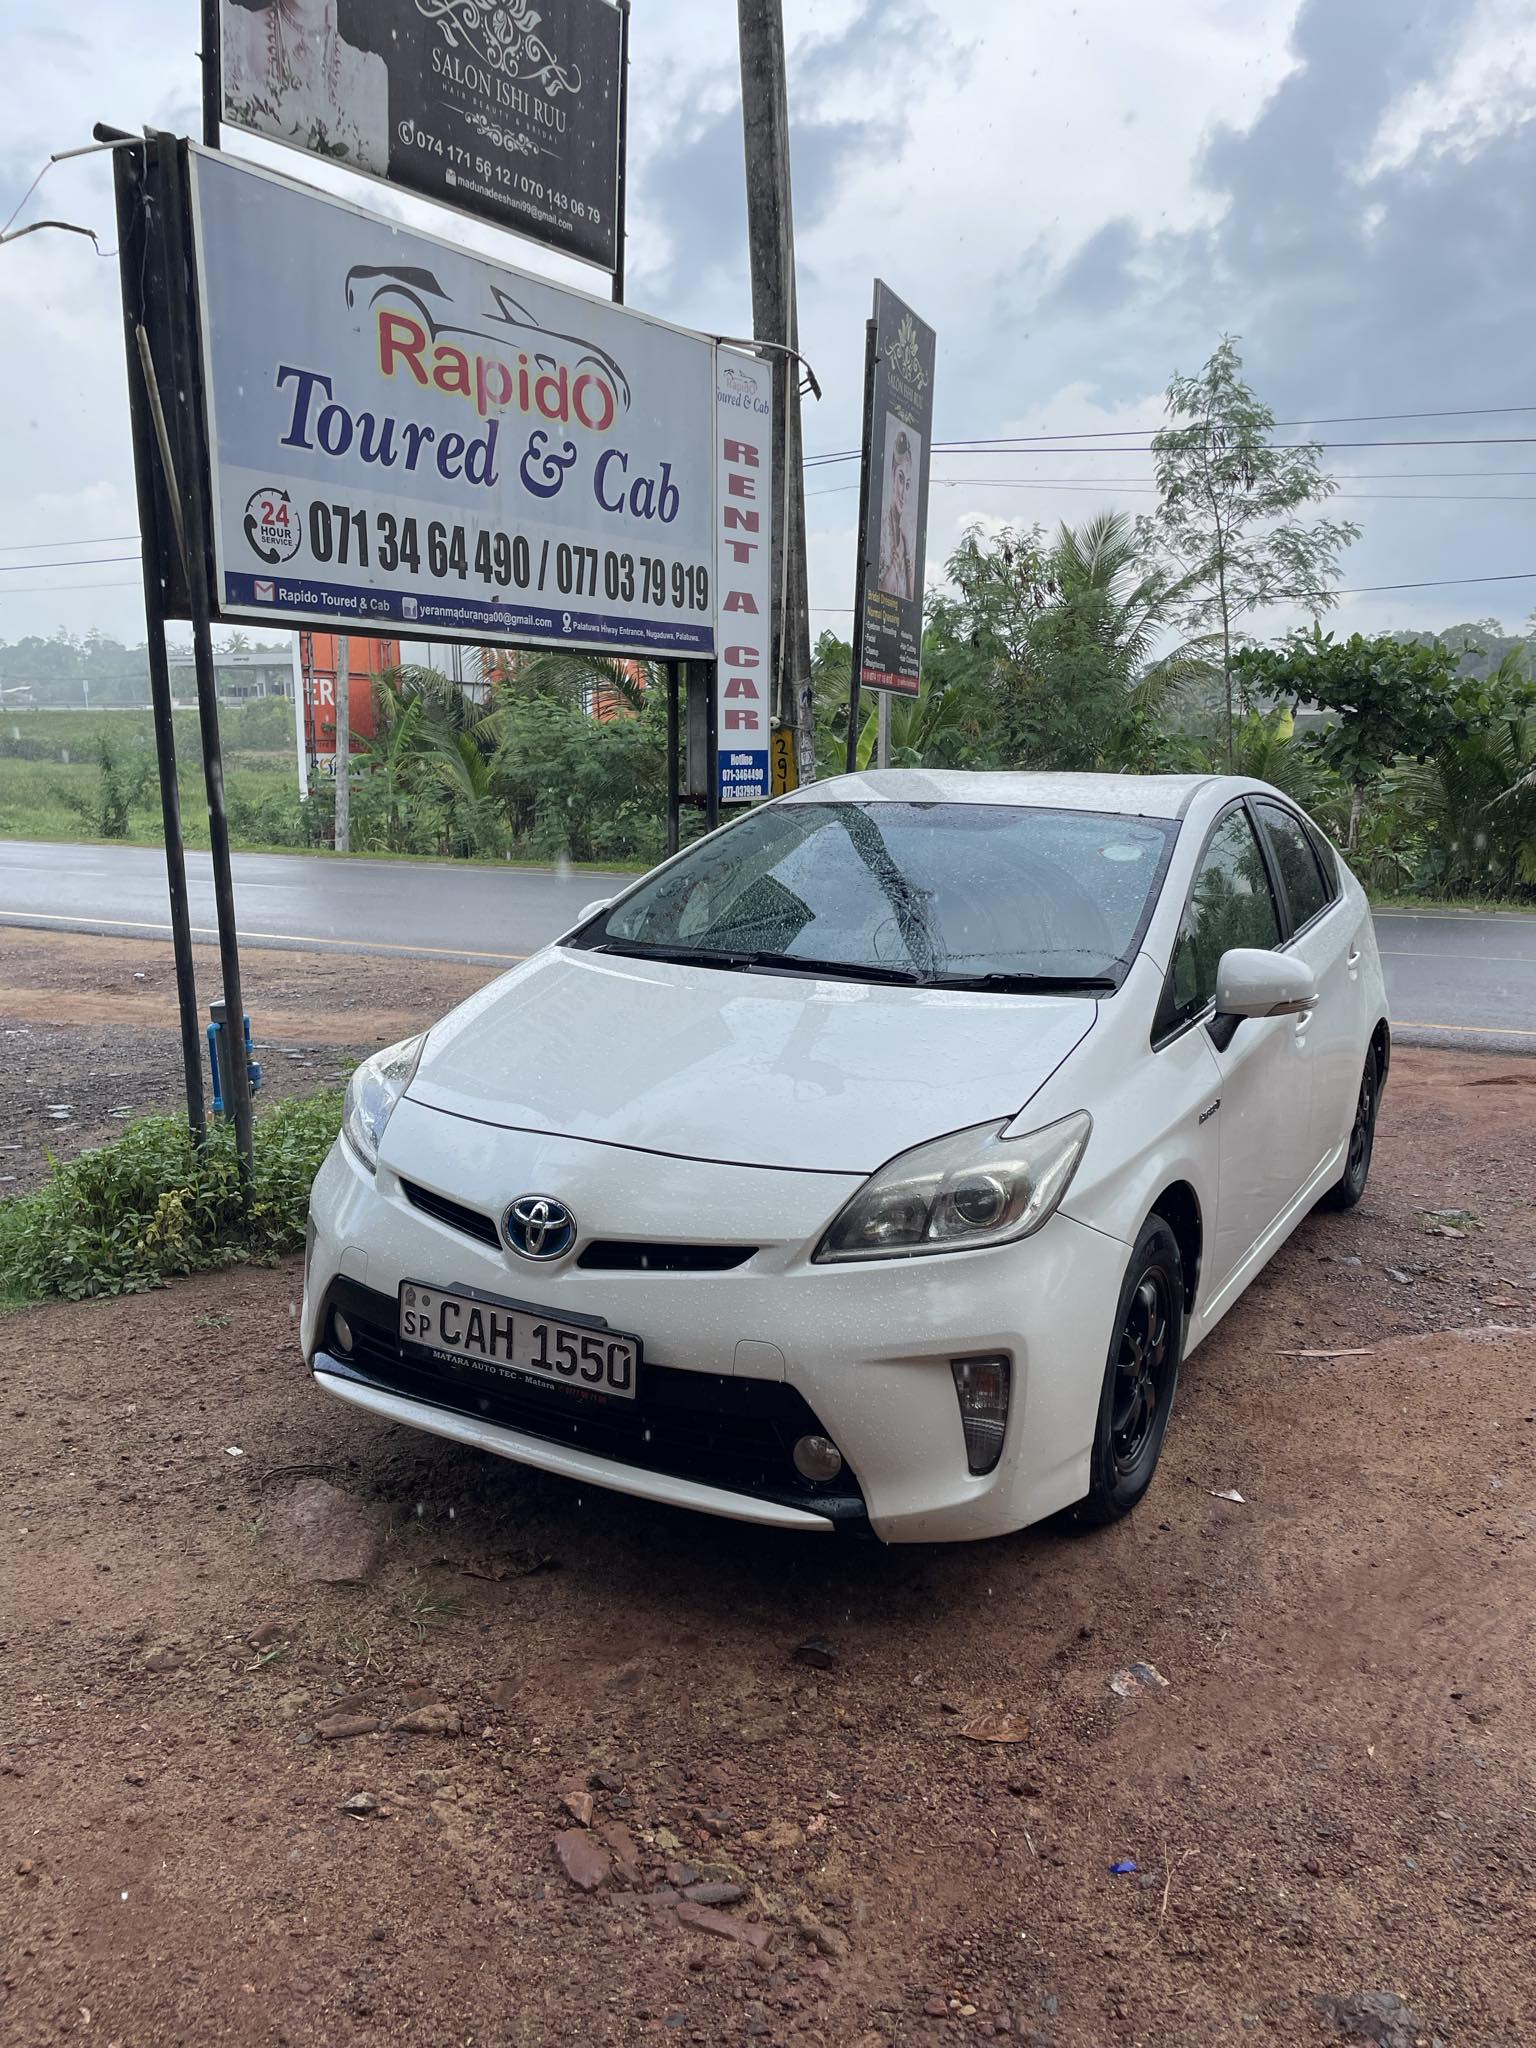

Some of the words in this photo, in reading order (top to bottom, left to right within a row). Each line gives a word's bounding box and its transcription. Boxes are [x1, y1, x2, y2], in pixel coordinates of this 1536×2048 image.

[432, 48, 491, 97] SALON
[496, 78, 528, 116] ISHI
[534, 97, 566, 133] RUU
[442, 83, 466, 100] HAIR
[416, 131, 443, 156] 074
[447, 145, 471, 168] 171
[475, 157, 492, 177] 56
[495, 166, 511, 185] 12
[521, 176, 544, 199] 070
[547, 188, 568, 210] 143
[570, 199, 585, 217] 06
[587, 206, 601, 224] 79
[717, 391, 741, 407] oured
[743, 394, 751, 410] &
[753, 397, 769, 415] Cab
[275, 364, 499, 487] Toured
[520, 429, 577, 498] &
[593, 448, 680, 523] Cab
[260, 501, 290, 527] 24
[724, 438, 759, 564] RENT
[260, 526, 291, 539] HOUR
[261, 535, 292, 547] SERVICE
[308, 500, 369, 568] 071
[377, 512, 421, 575] 34
[427, 521, 468, 580] 64
[474, 529, 530, 589] 490
[537, 540, 549, 591] /
[556, 543, 598, 597] 077
[604, 551, 635, 602] 03
[640, 556, 666, 607] 79
[671, 561, 709, 611] 919
[279, 588, 318, 605] Rapido
[320, 592, 357, 608] Toured
[359, 599, 368, 610] &
[370, 599, 390, 612] Cab
[723, 591, 759, 614] A
[420, 605, 552, 627] yeranmaduranga00@gmail.com
[305, 678, 335, 706] ER
[723, 646, 759, 730] CAR
[730, 753, 753, 766] Hotline
[404, 1310, 431, 1339] SP
[439, 1301, 513, 1360] CAH
[531, 1324, 631, 1391] 1550
[433, 1350, 470, 1367] MATARA
[471, 1361, 497, 1374] AUTO
[499, 1368, 517, 1379] TEC
[524, 1375, 555, 1390] Matara
